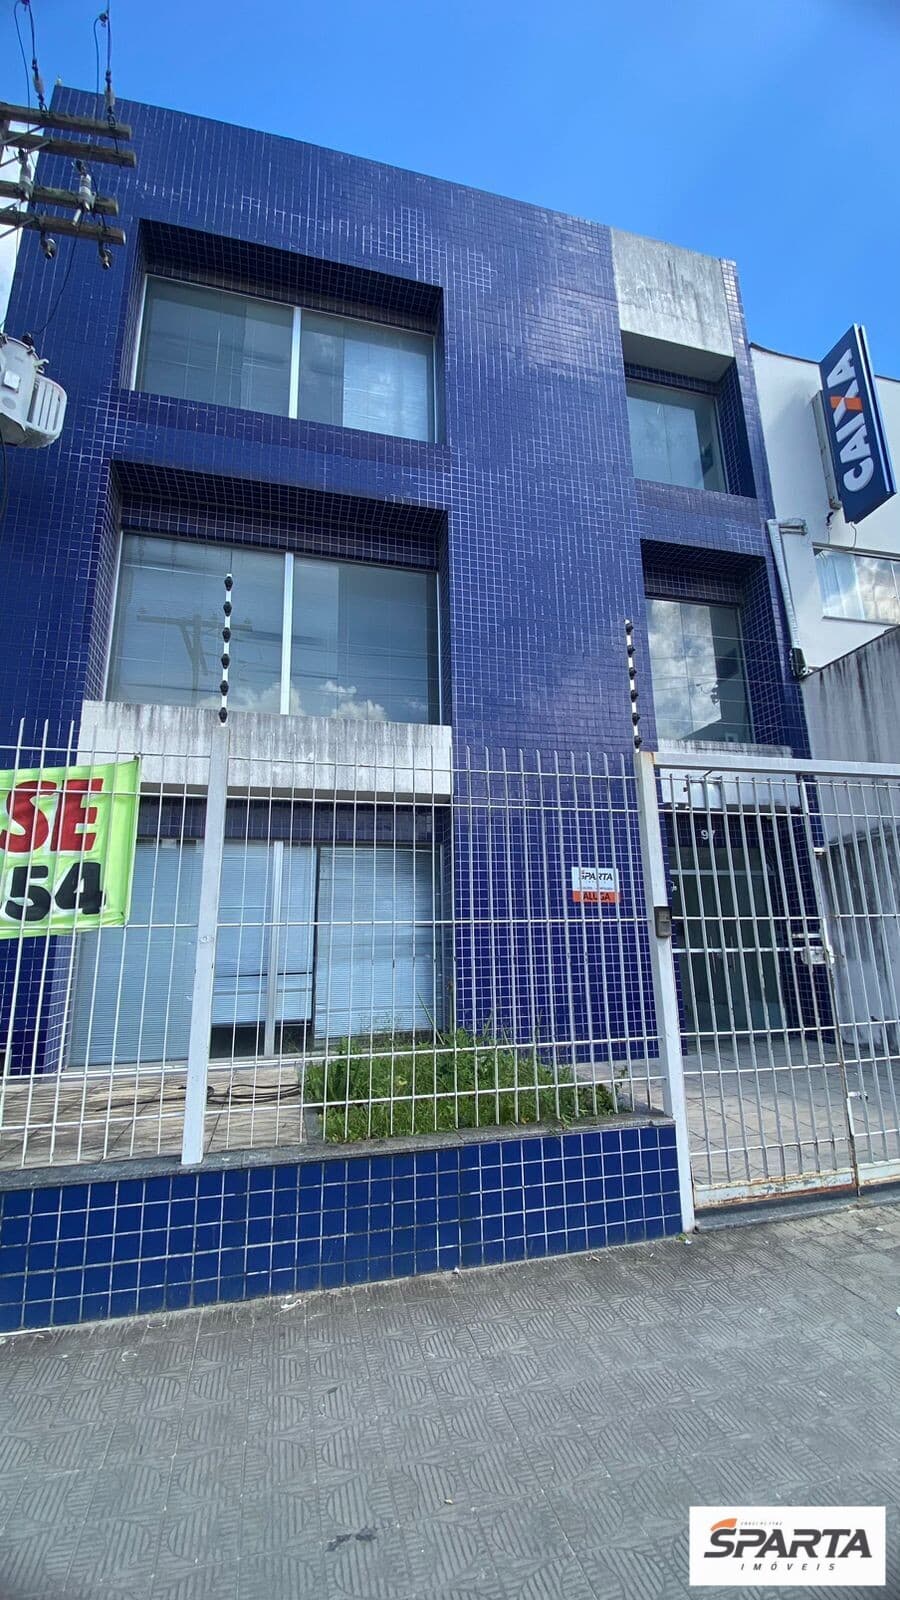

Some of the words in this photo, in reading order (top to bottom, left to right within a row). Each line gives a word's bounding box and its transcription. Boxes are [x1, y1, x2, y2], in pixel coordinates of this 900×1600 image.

[826, 348, 874, 492] CAIXA
[0, 778, 104, 853] SE
[4, 861, 107, 922] 54
